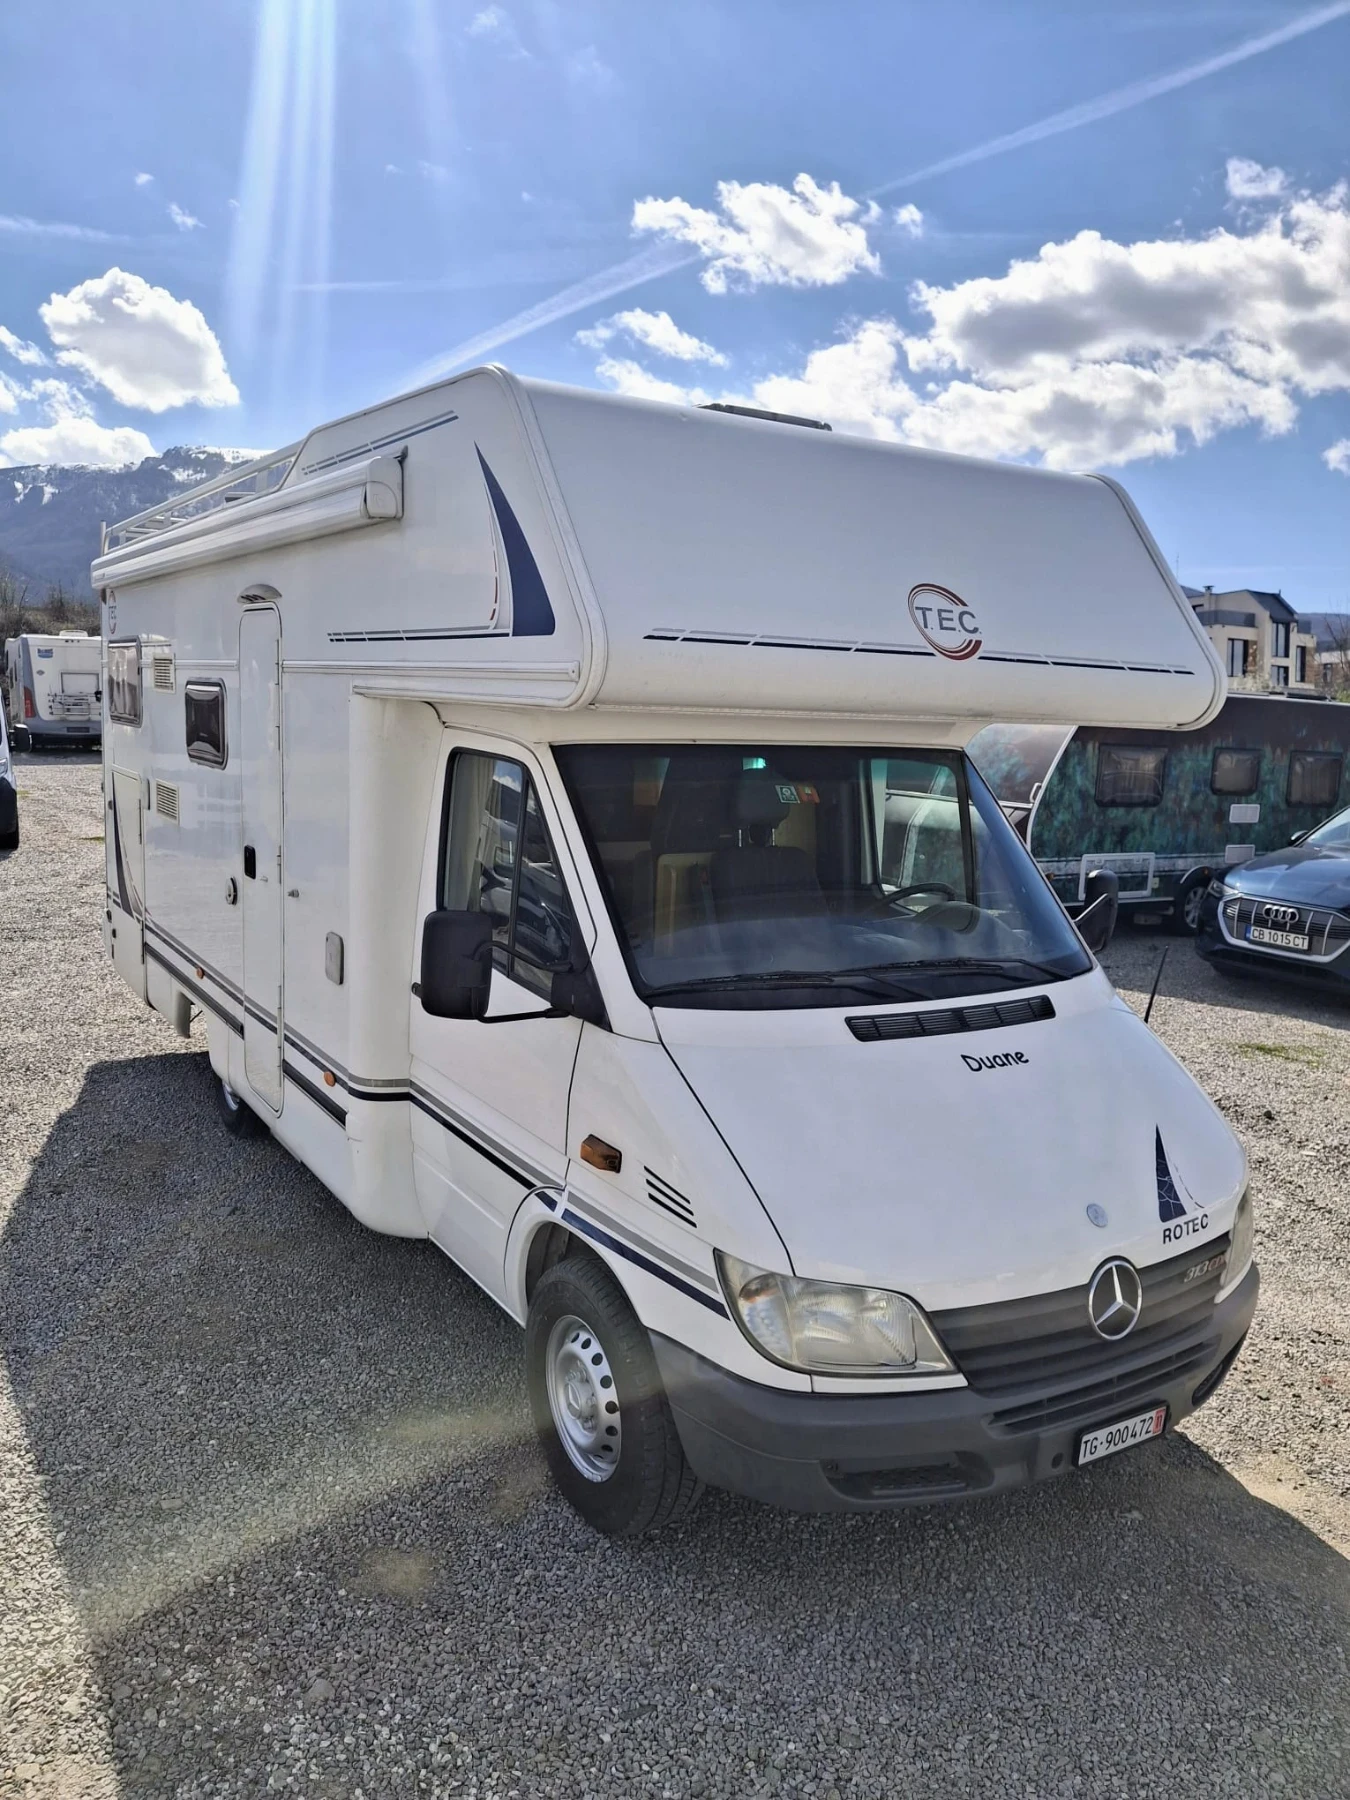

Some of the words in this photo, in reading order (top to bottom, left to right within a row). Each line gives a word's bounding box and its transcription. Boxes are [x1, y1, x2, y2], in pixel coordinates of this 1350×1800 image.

[1252, 928, 1265, 940] CB
[1268, 931, 1291, 945] 1015
[1293, 935, 1308, 948] CT
[960, 1051, 1029, 1072] Duane
[1162, 1213, 1209, 1244] ROTEC
